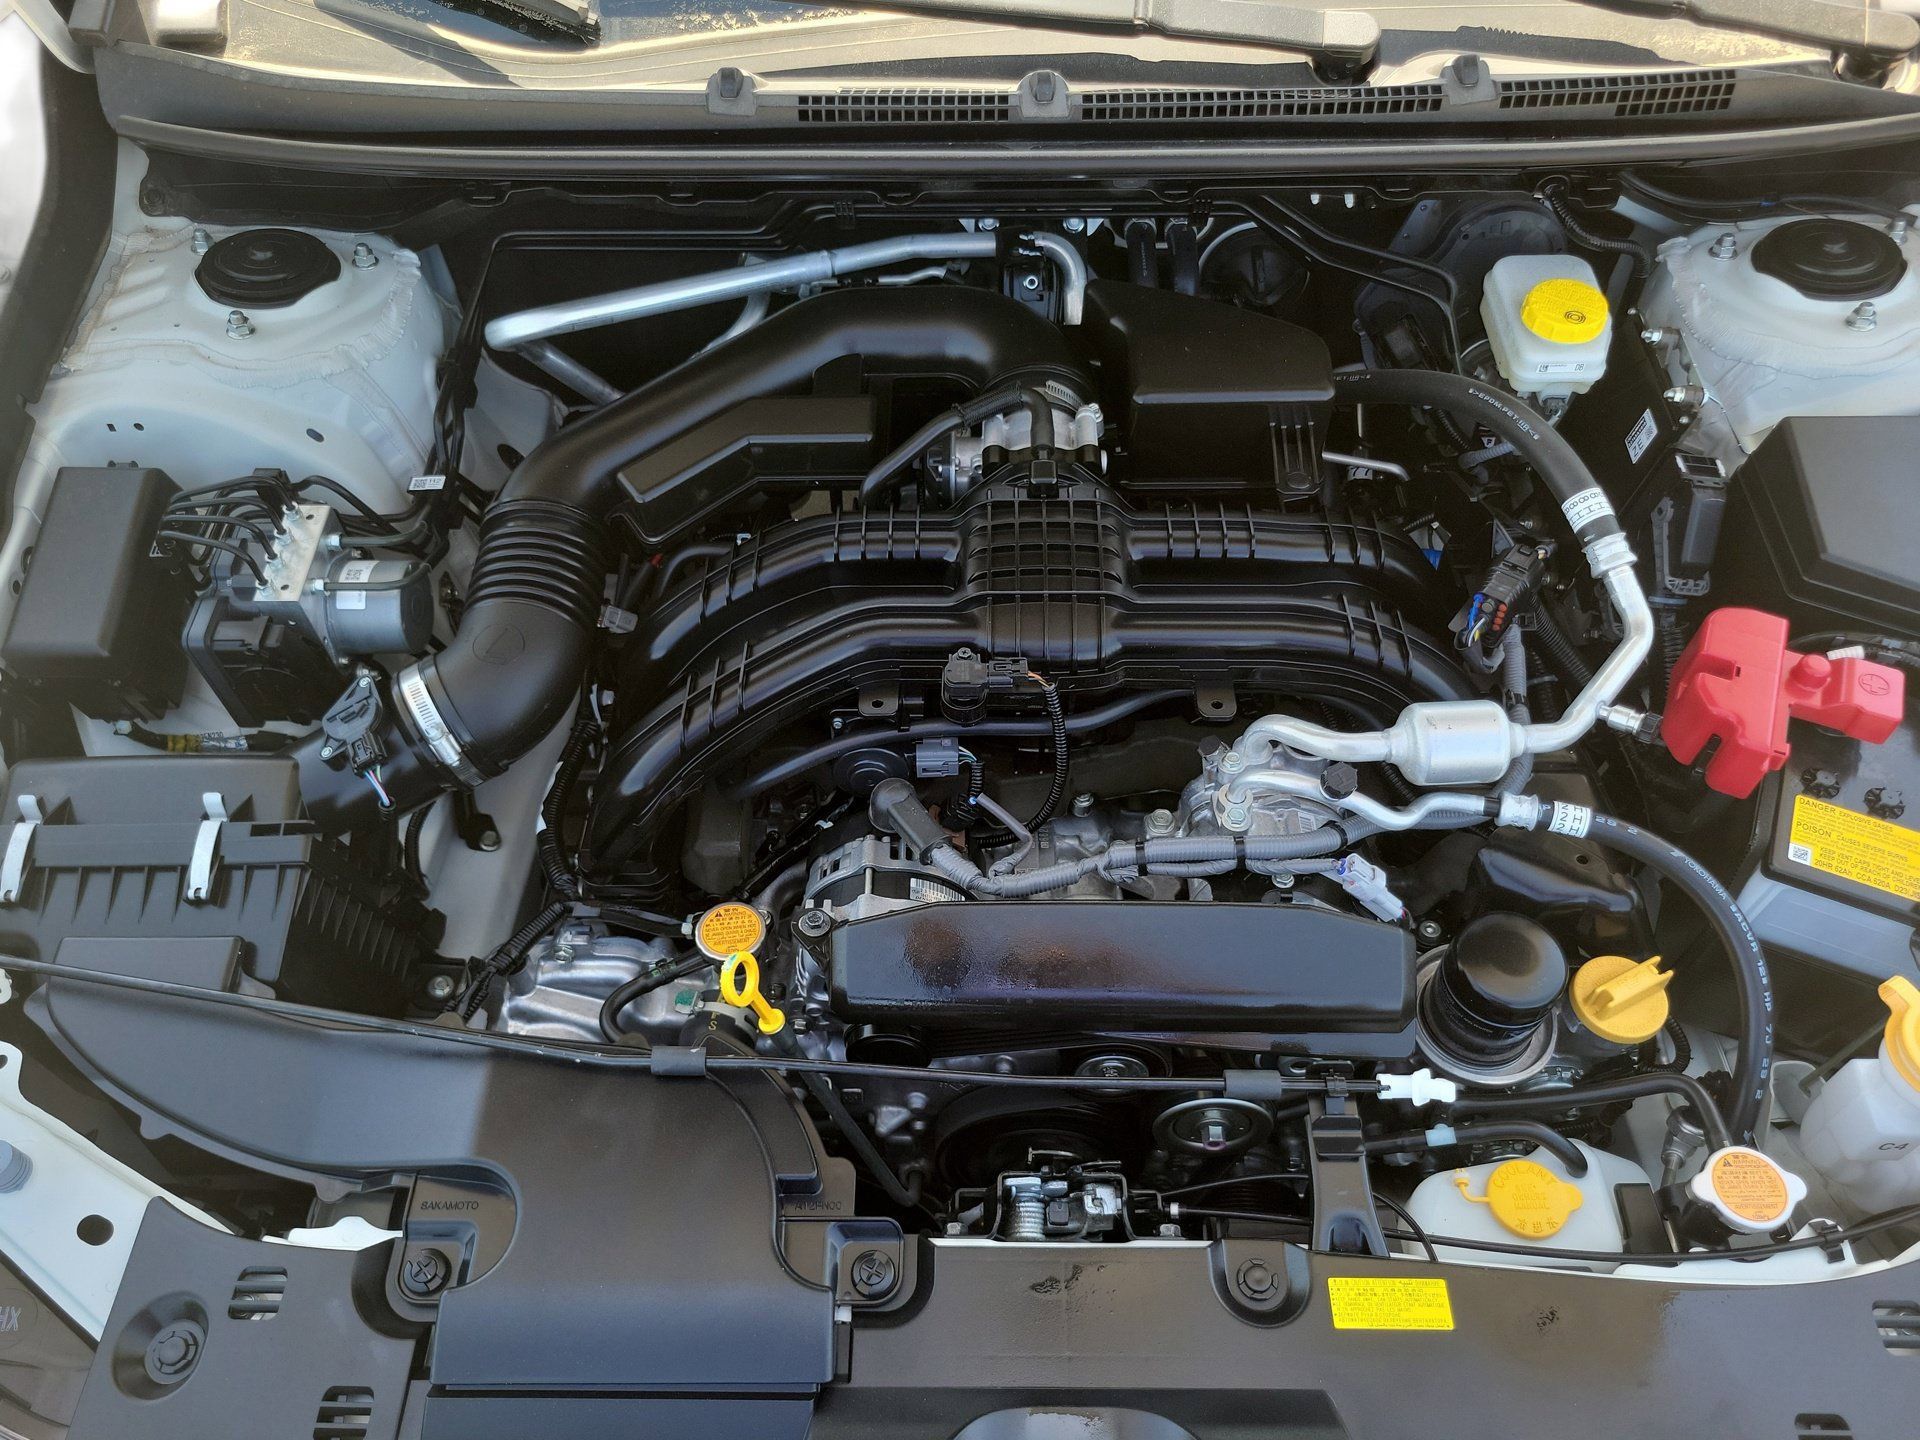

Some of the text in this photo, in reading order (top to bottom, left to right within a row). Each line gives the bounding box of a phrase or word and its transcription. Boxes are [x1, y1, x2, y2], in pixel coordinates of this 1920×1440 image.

[1799, 798, 1836, 815] DANGER
[1796, 821, 1832, 838] POISON
[1684, 858, 1727, 901] YOKOHAMA
[421, 1200, 480, 1211] SAKAMOTO
